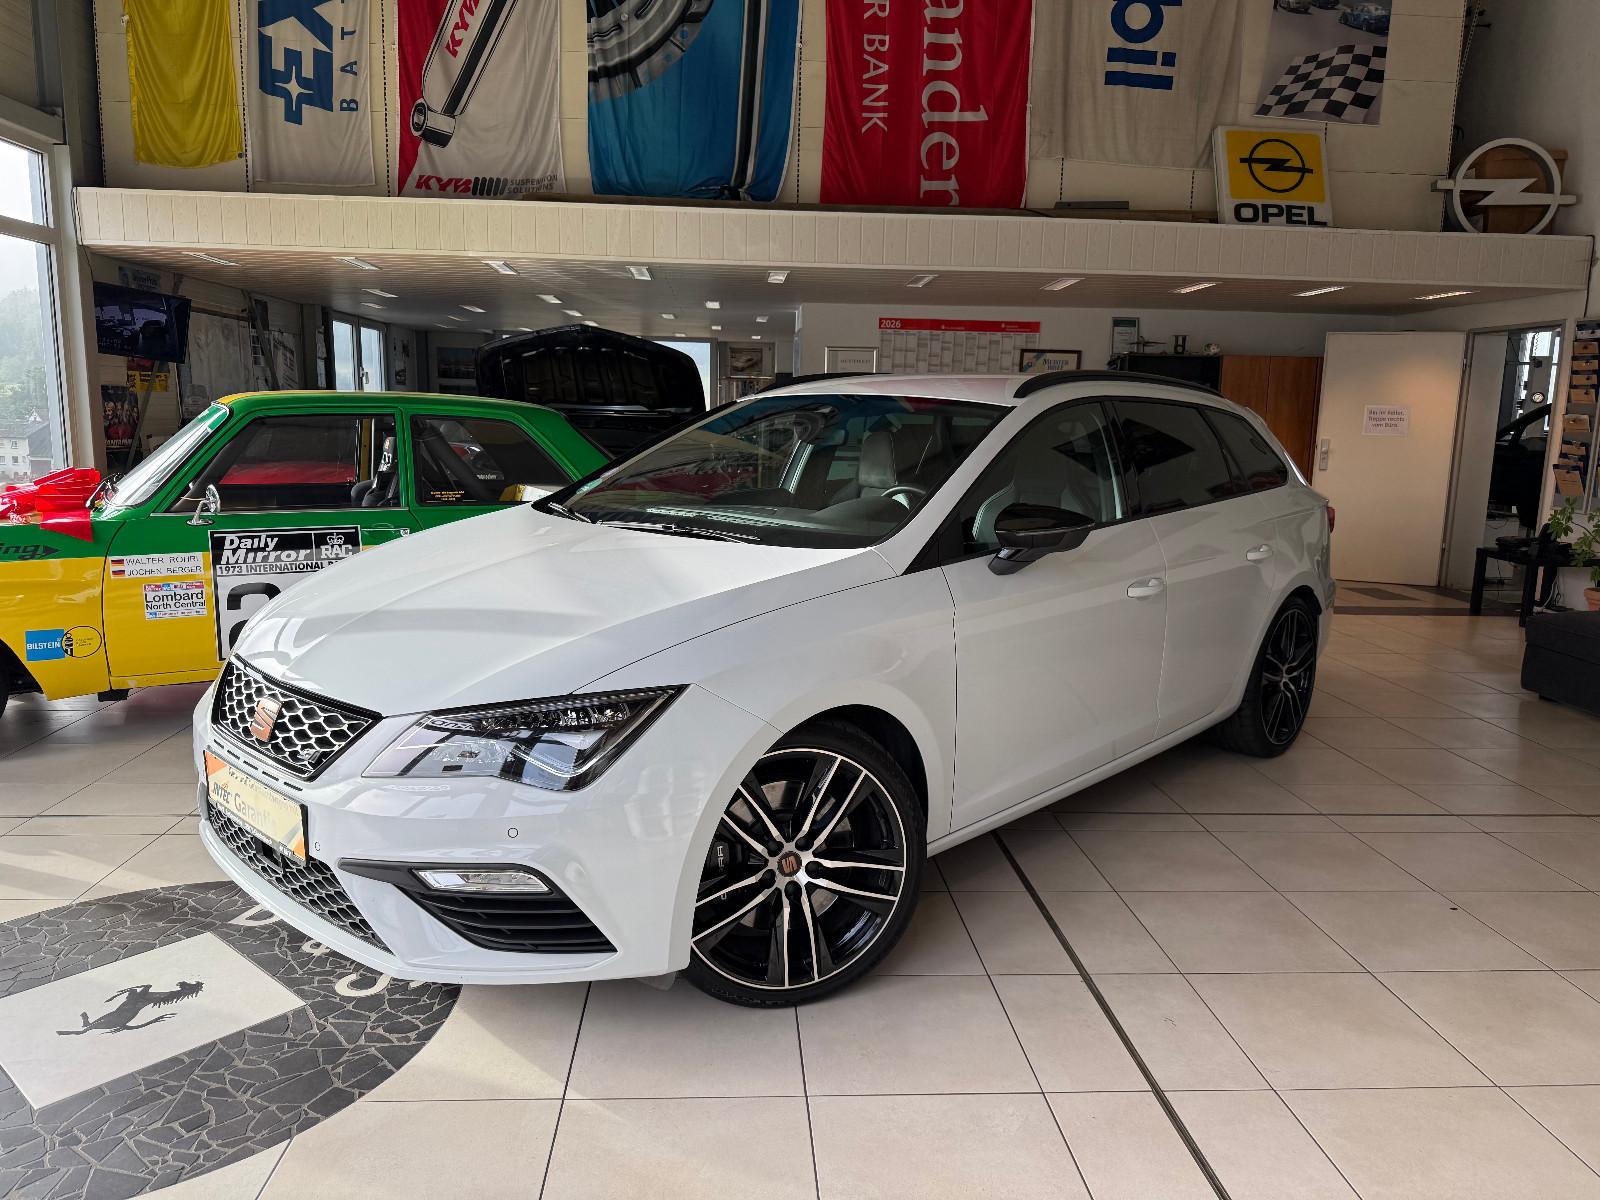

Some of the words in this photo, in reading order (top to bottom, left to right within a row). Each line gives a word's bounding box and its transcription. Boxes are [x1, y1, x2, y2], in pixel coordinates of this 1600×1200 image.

[340, 0, 358, 111] BAT
[861, 34, 889, 134] BANK
[415, 174, 473, 194] KYB
[510, 174, 558, 186] SUSPENION
[506, 182, 555, 194] SOLUTINS
[1233, 203, 1328, 226] OPEL
[880, 319, 901, 329] 2026
[223, 534, 279, 551] Daily
[125, 556, 164, 565] WALTER
[220, 549, 311, 565] Mirror
[320, 544, 353, 559] RAC
[127, 568, 162, 577] JOCHEN
[166, 565, 202, 574] BERGER
[218, 565, 243, 575] 1973
[246, 561, 325, 574] INTERNATIONAL
[144, 590, 204, 603] Lombard
[146, 602, 171, 611] North
[174, 600, 205, 609] Central
[26, 641, 61, 650] BILSTEIN
[234, 792, 277, 832] Garanti
